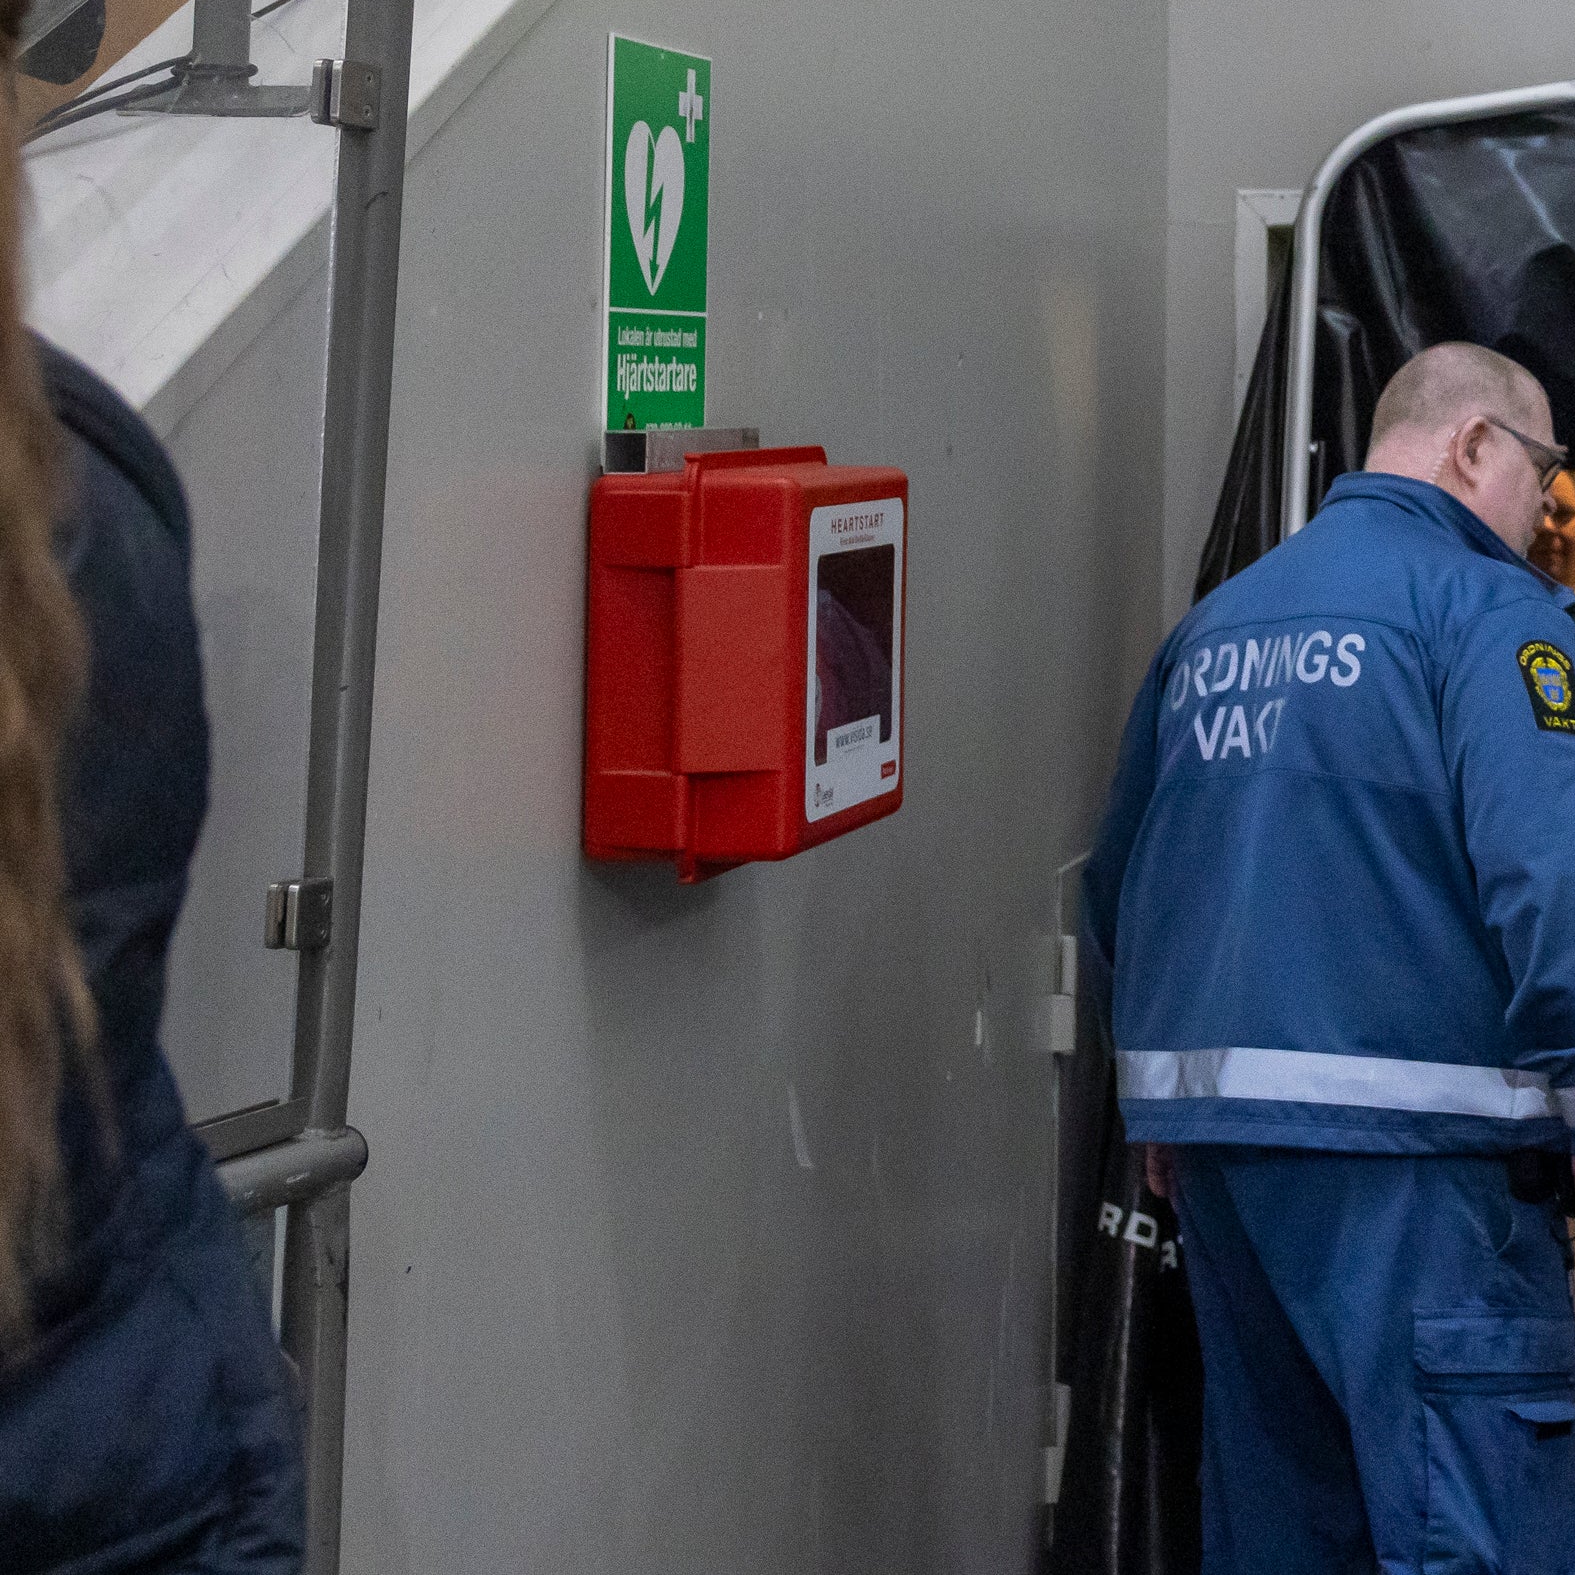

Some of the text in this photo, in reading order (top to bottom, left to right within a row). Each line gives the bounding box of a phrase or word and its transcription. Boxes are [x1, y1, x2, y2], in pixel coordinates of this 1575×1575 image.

[618, 326, 698, 348] Lokalen är utrustad med
[617, 354, 697, 401] Hjärtstartare
[831, 512, 884, 534] HEARTSTART
[1170, 630, 1366, 711] ORDNINGS
